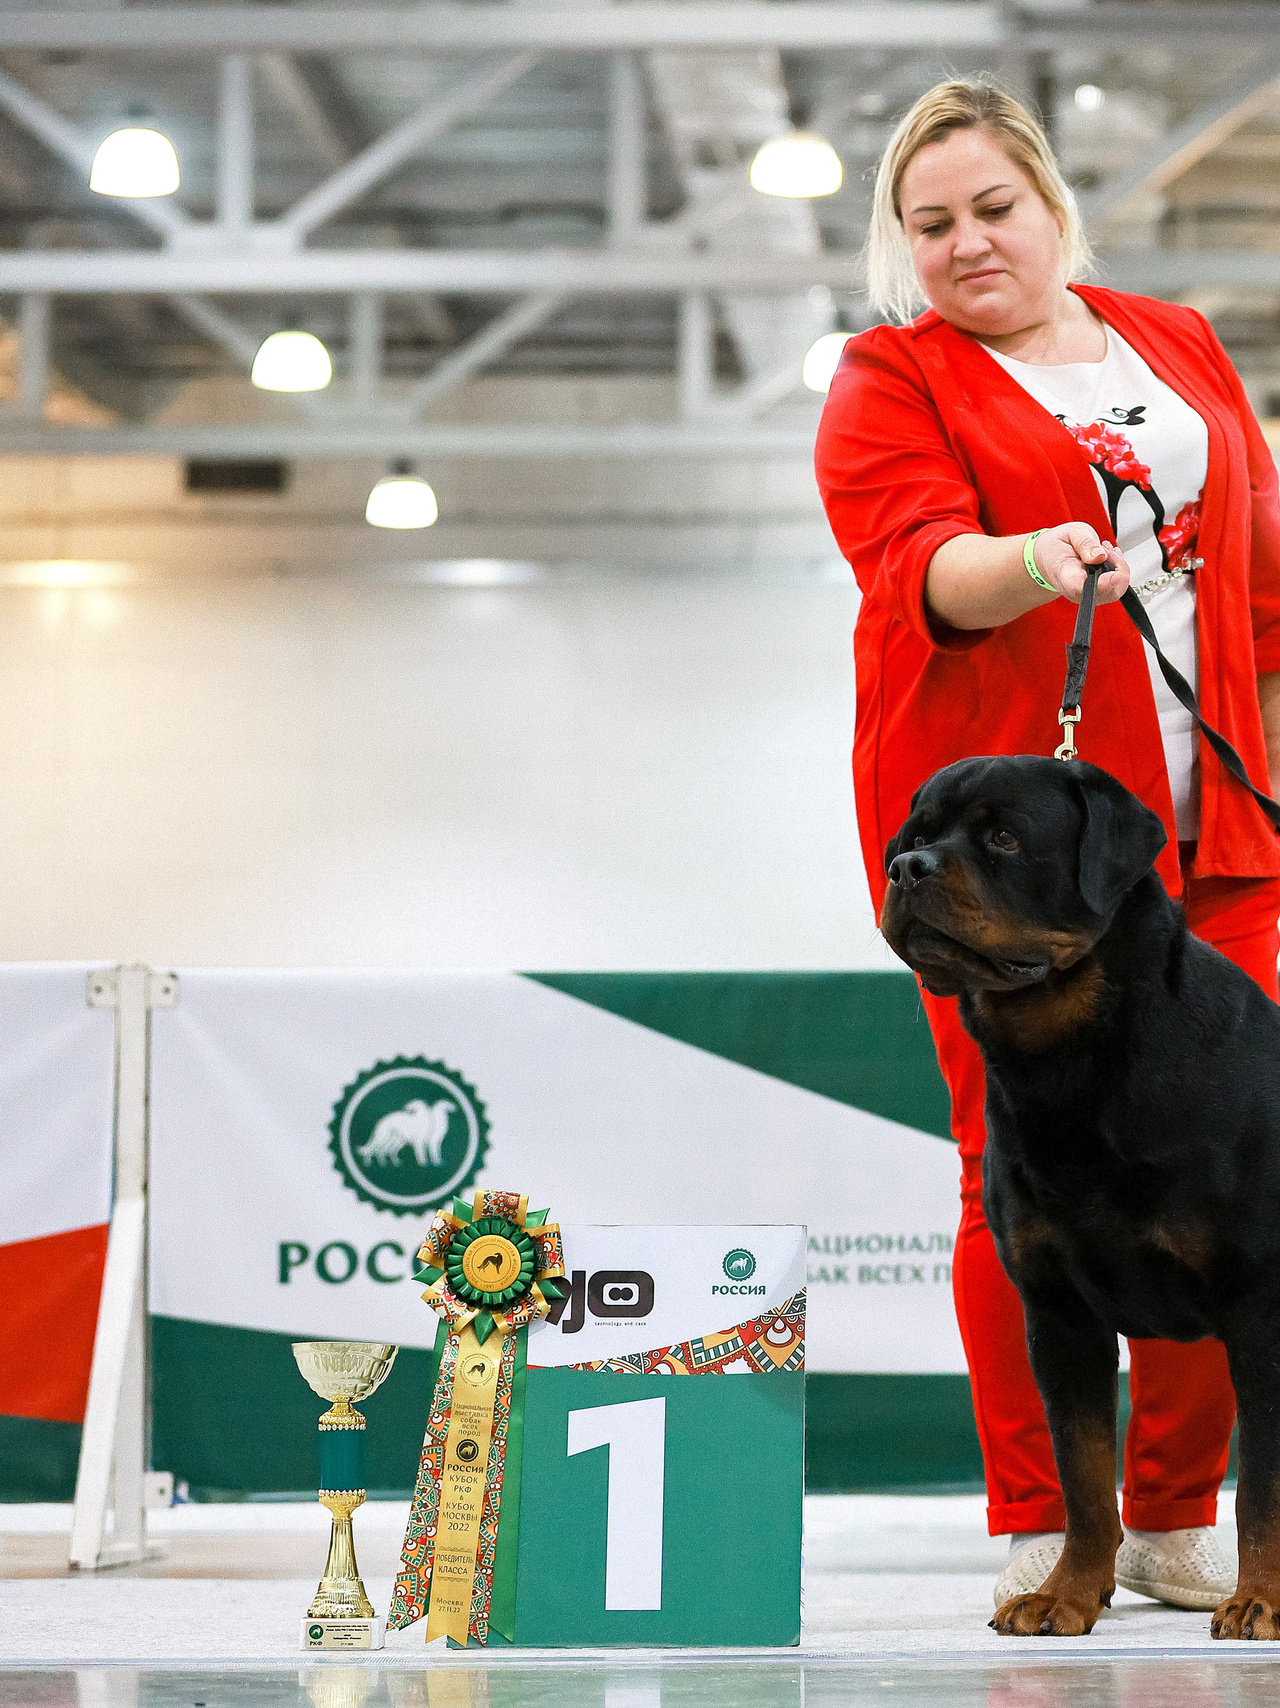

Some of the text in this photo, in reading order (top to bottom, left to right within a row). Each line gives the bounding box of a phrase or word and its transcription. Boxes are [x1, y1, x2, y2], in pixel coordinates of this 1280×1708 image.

[858, 1263, 924, 1285] ВСЕХ
[712, 1285, 766, 1295] РОССИЯ
[458, 1429, 480, 1437] пород
[447, 1463, 484, 1474] РОССИЯ
[449, 1475, 478, 1484] КУБОК
[453, 1485, 472, 1493] РКФ
[446, 1502, 475, 1511] КУБОК
[567, 1396, 666, 1610] 1
[441, 1512, 478, 1521] МОСКВЫ
[447, 1522, 470, 1531] 2022
[436, 1553, 474, 1564] ПОБЕДИТЕЛЬ
[438, 1565, 468, 1575] КЛАССА
[436, 1597, 464, 1606] Москва
